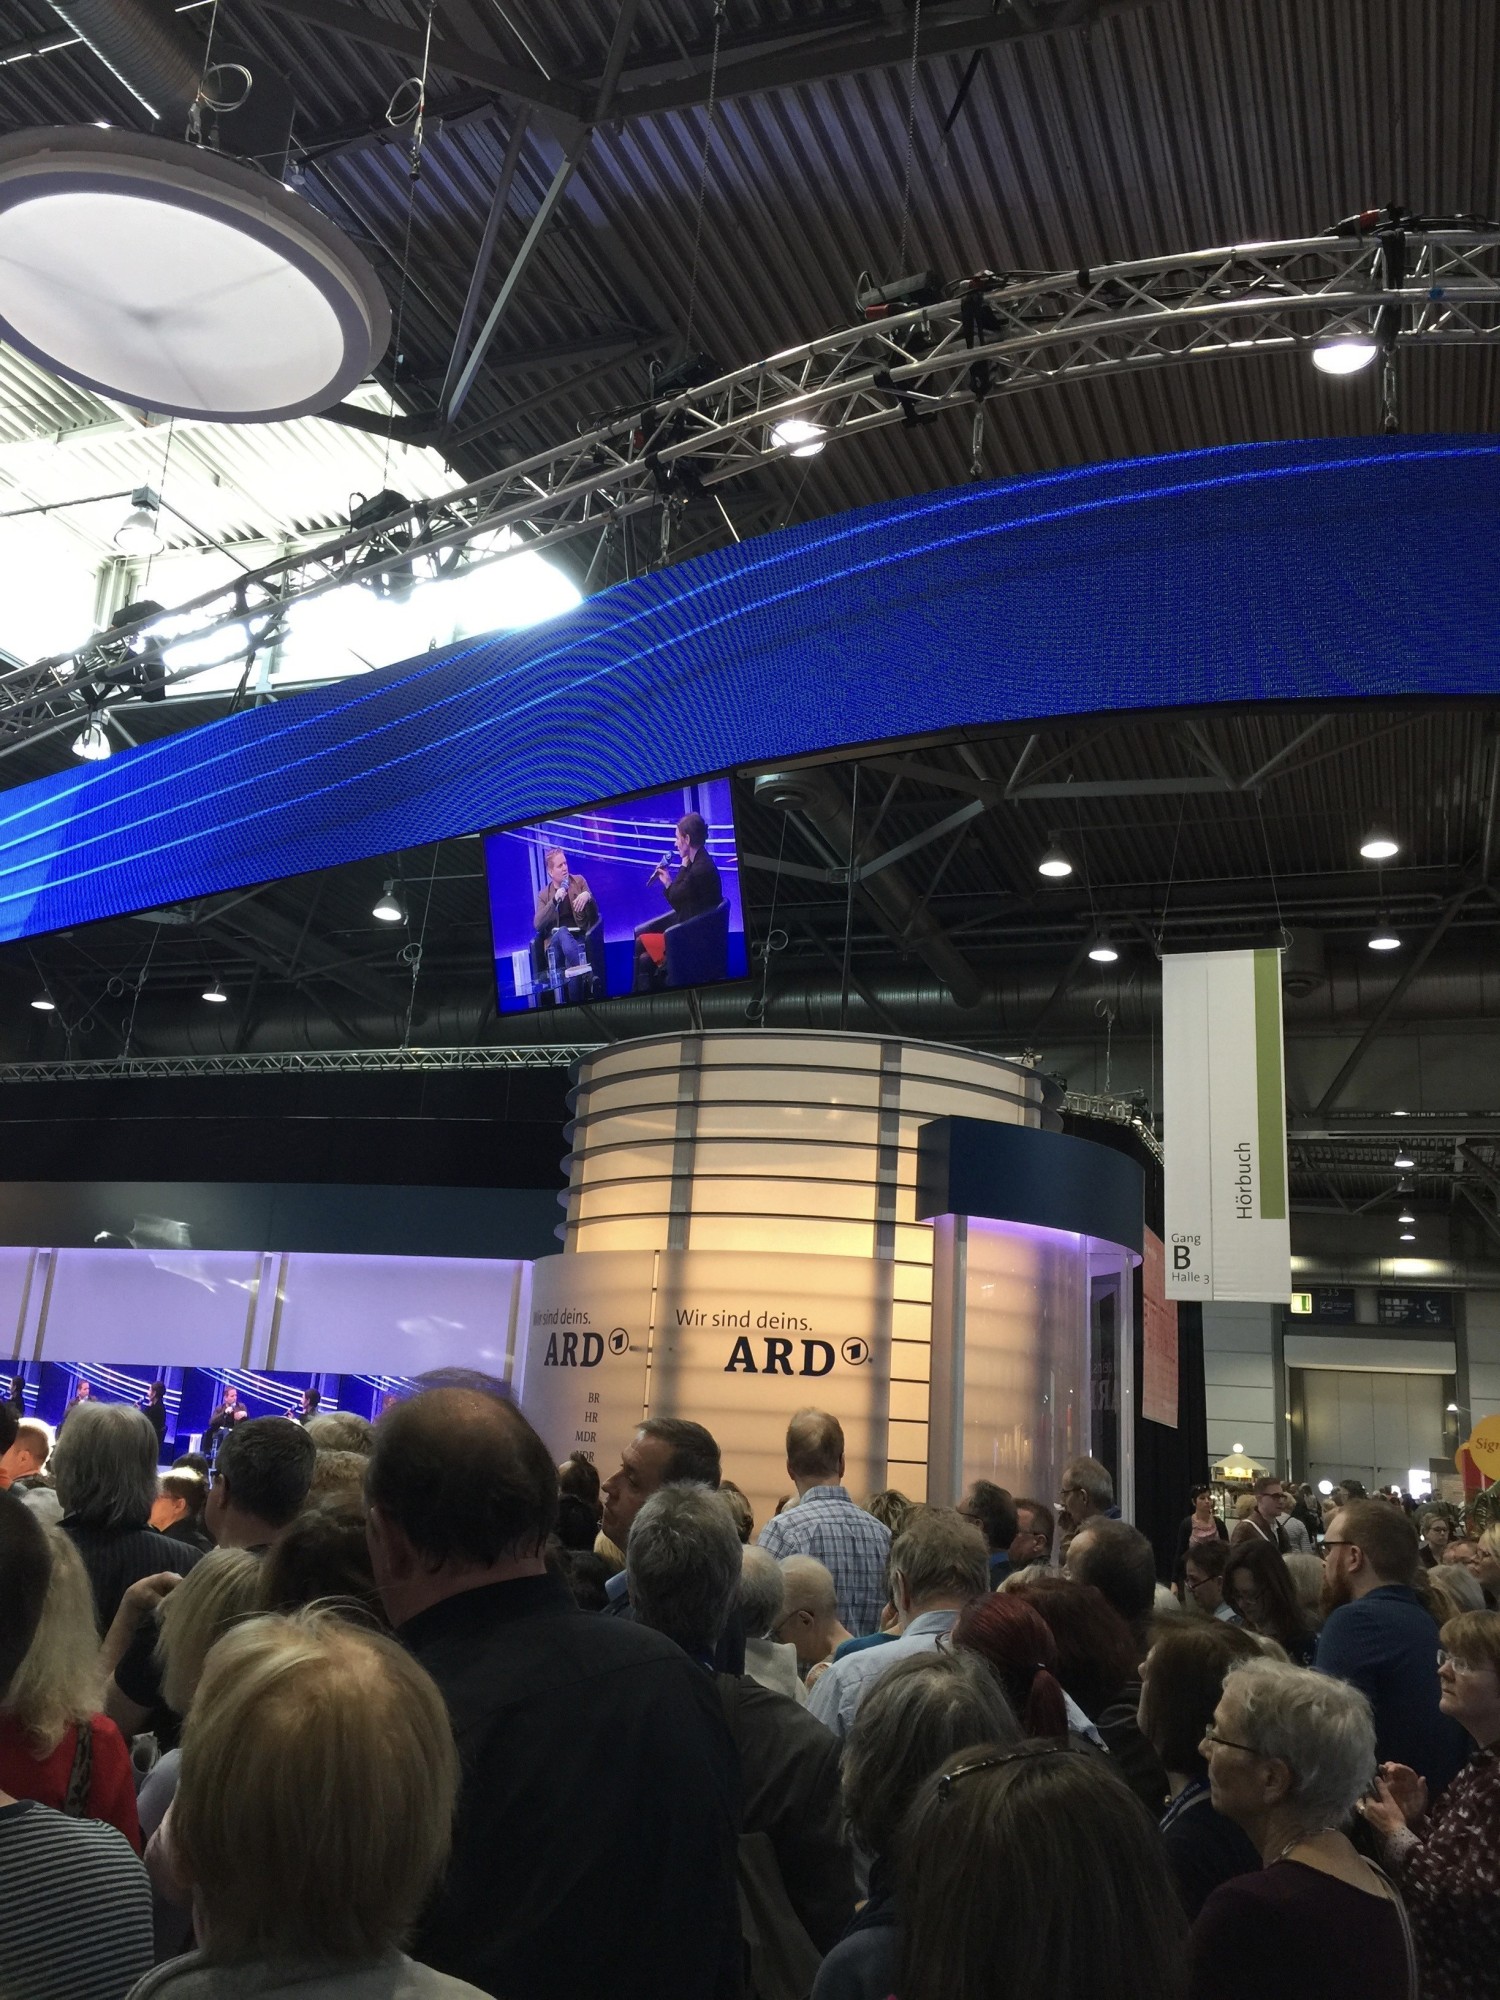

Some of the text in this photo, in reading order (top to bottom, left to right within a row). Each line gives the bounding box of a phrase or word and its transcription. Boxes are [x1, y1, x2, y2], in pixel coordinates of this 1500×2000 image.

[1233, 1142, 1253, 1219] Hörbuch
[1171, 1233, 1201, 1246] Gang
[1174, 1245, 1191, 1270] B
[1171, 1271, 1210, 1285] Halle 3
[542, 1308, 559, 1326] sind
[560, 1307, 591, 1325] deins.
[676, 1309, 813, 1332] Wir sind deins.
[544, 1331, 604, 1368] ARD
[724, 1336, 836, 1377] ARD
[588, 1392, 600, 1404] BR
[584, 1411, 598, 1423] HR
[575, 1430, 597, 1443] MDR
